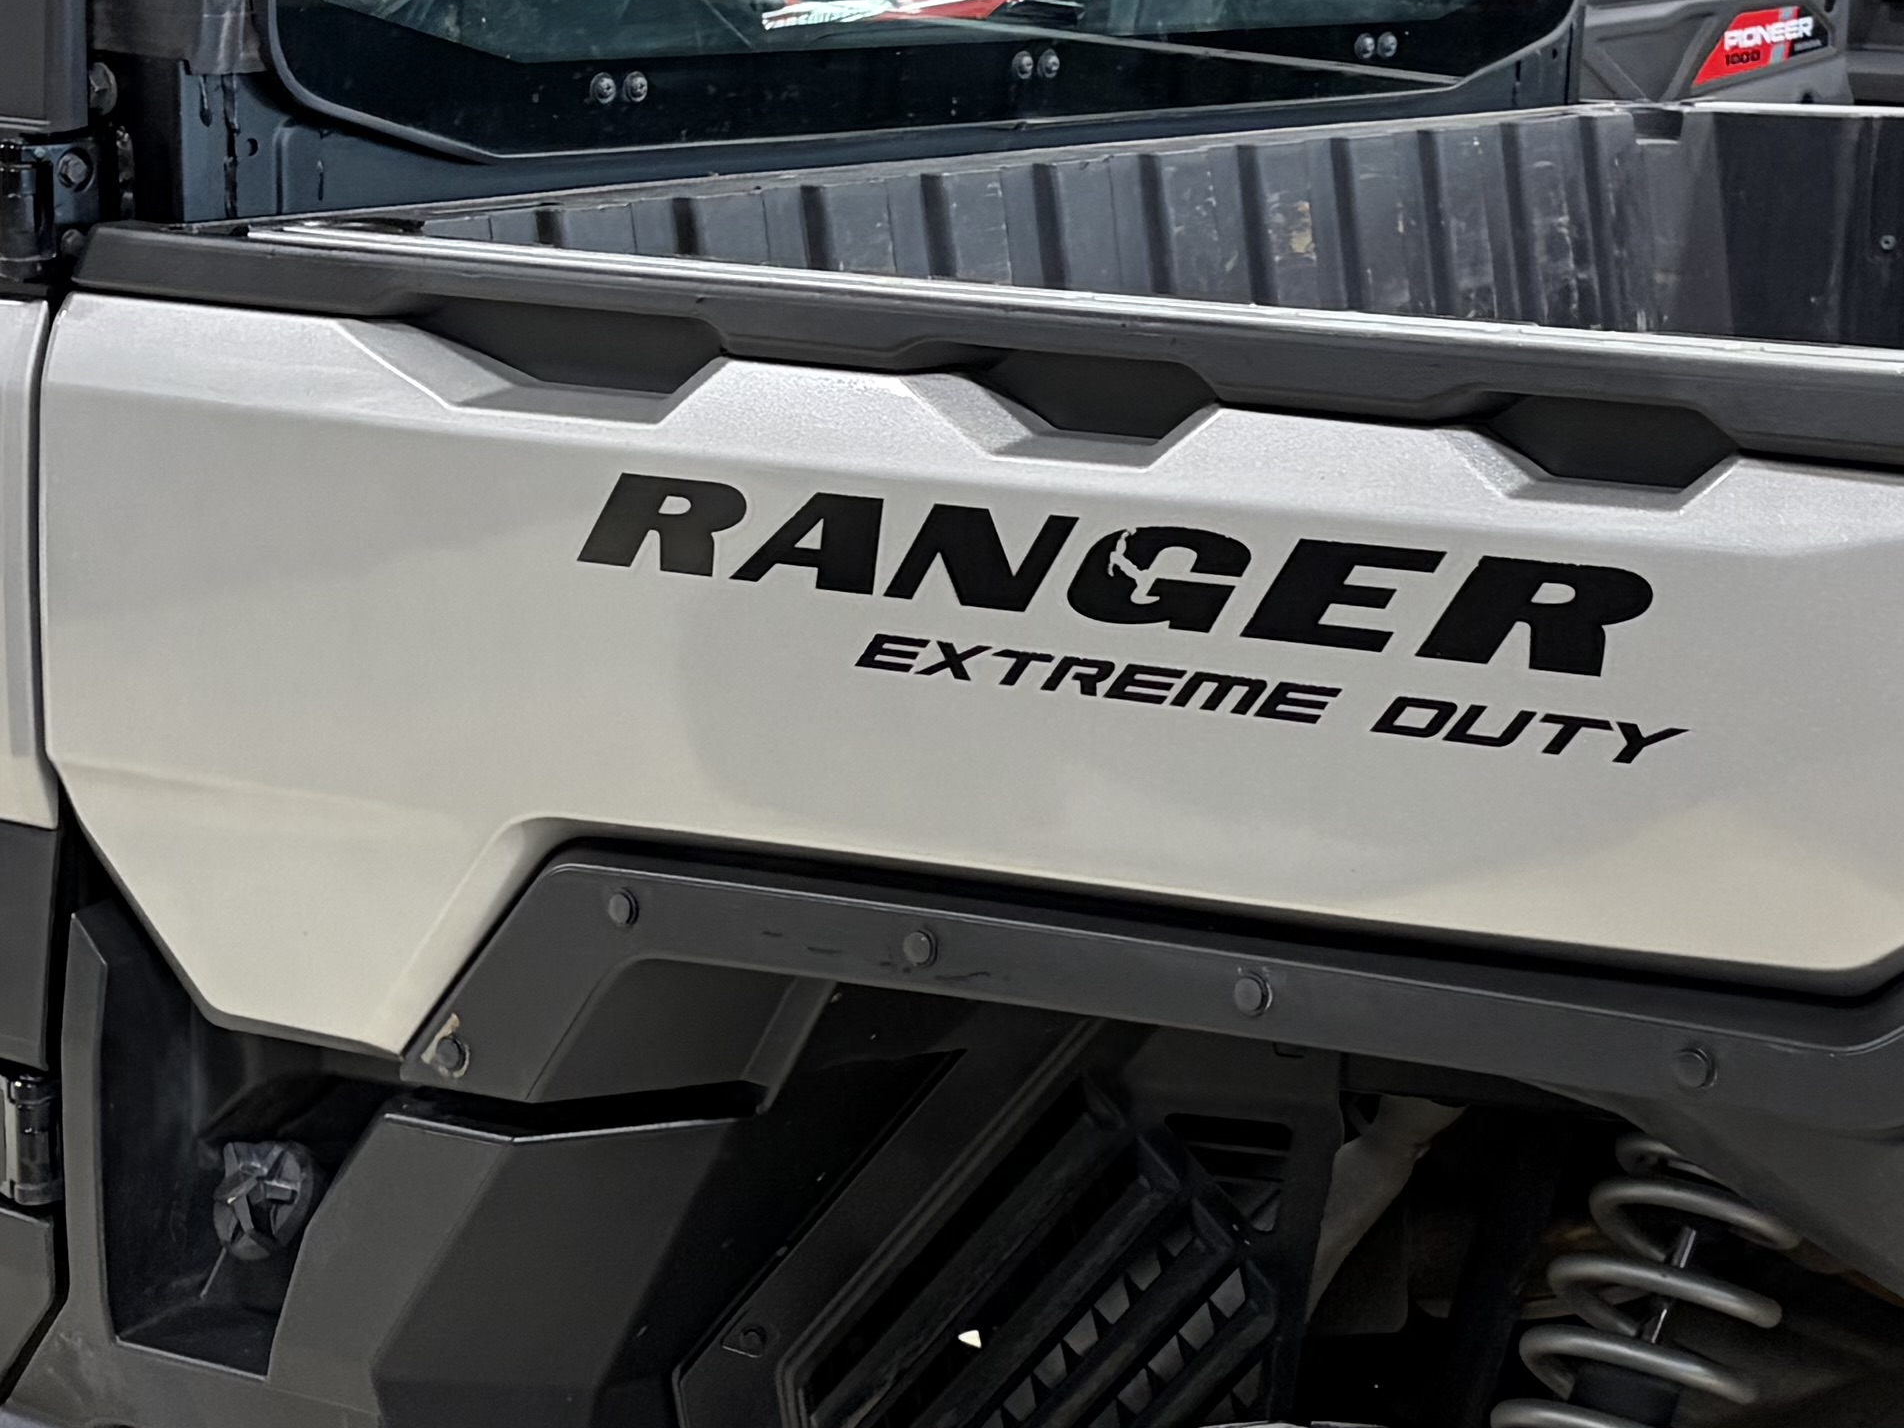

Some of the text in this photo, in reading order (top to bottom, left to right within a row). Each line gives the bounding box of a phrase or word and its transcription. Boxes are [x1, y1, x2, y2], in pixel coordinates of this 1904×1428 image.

[1723, 16, 1814, 51] PIONEER
[1725, 49, 1761, 66] 1000
[576, 471, 1655, 678] RANGER
[854, 632, 1690, 765] EXTREME DUTY
